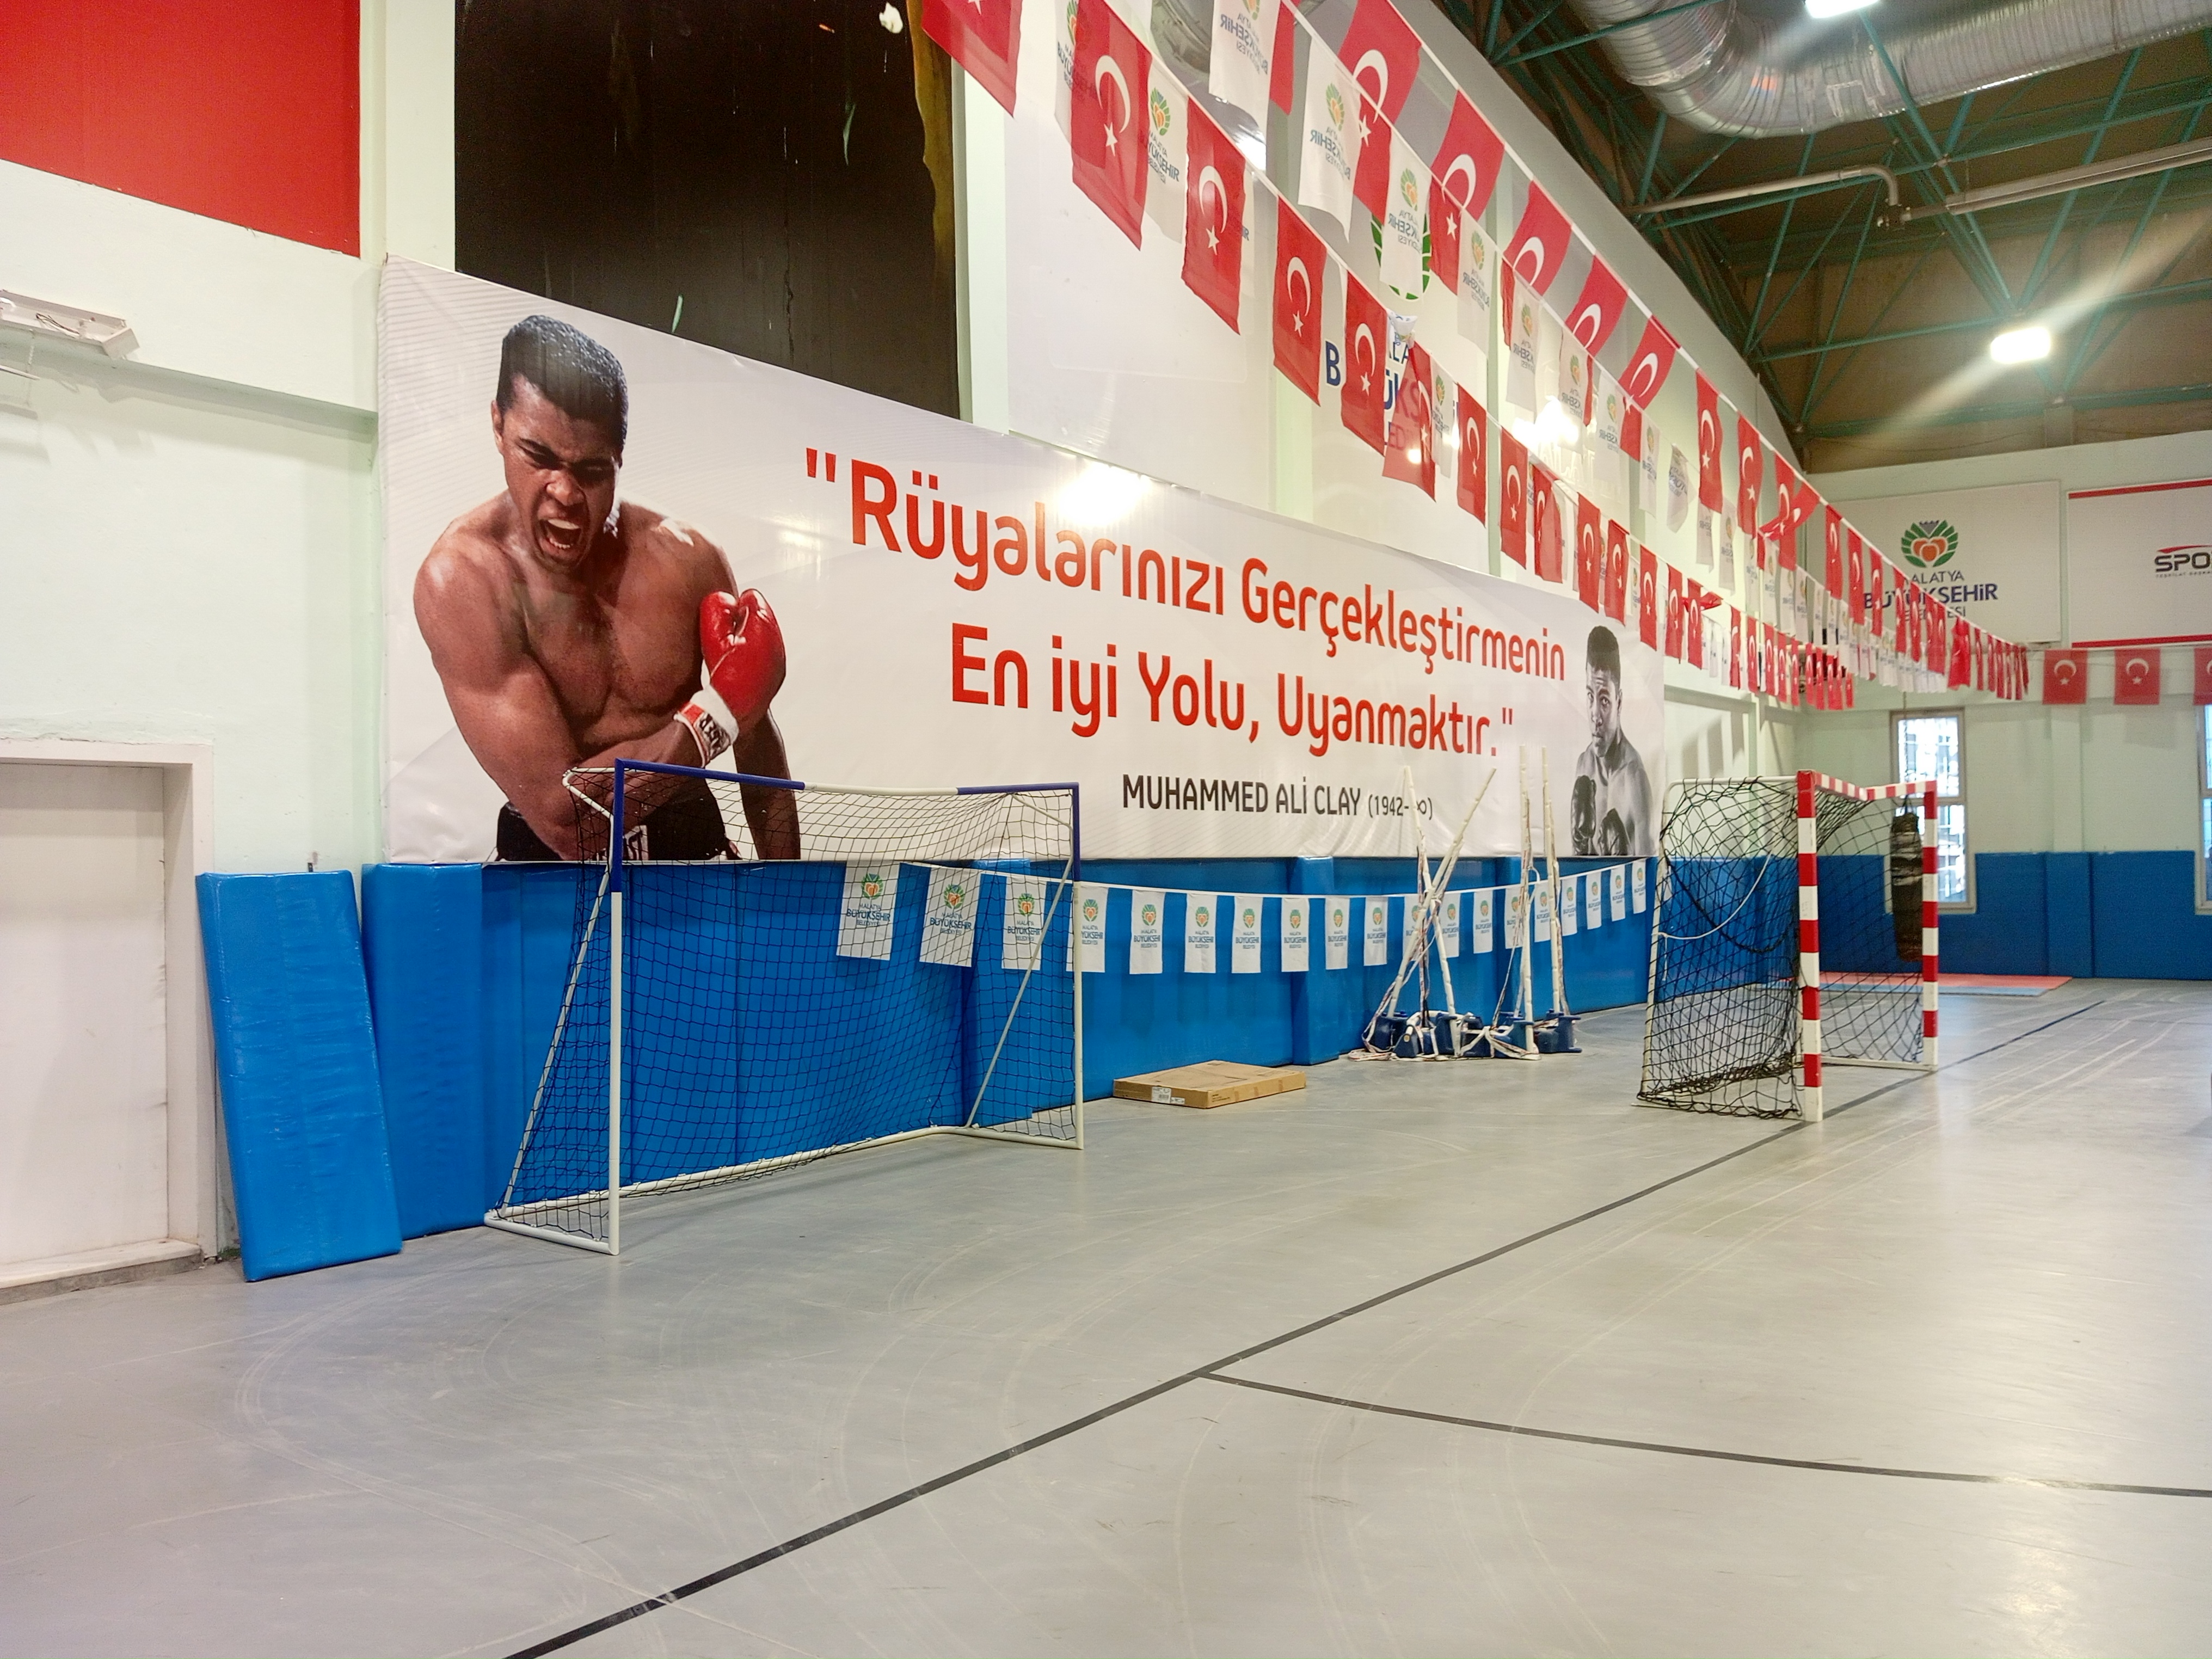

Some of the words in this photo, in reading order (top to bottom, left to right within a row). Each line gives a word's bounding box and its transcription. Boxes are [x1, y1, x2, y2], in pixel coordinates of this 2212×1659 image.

[1905, 570, 1965, 585] ALATYA
[2155, 551, 2212, 572] SPO
[1242, 558, 1565, 681] Gerçekleştirmenin
[952, 623, 1028, 709] En
[1052, 635, 1117, 738] iyi
[1138, 651, 1259, 744] Yolu,
[1123, 773, 1269, 813] MUHAMMED
[1314, 785, 1361, 815] CLAY
